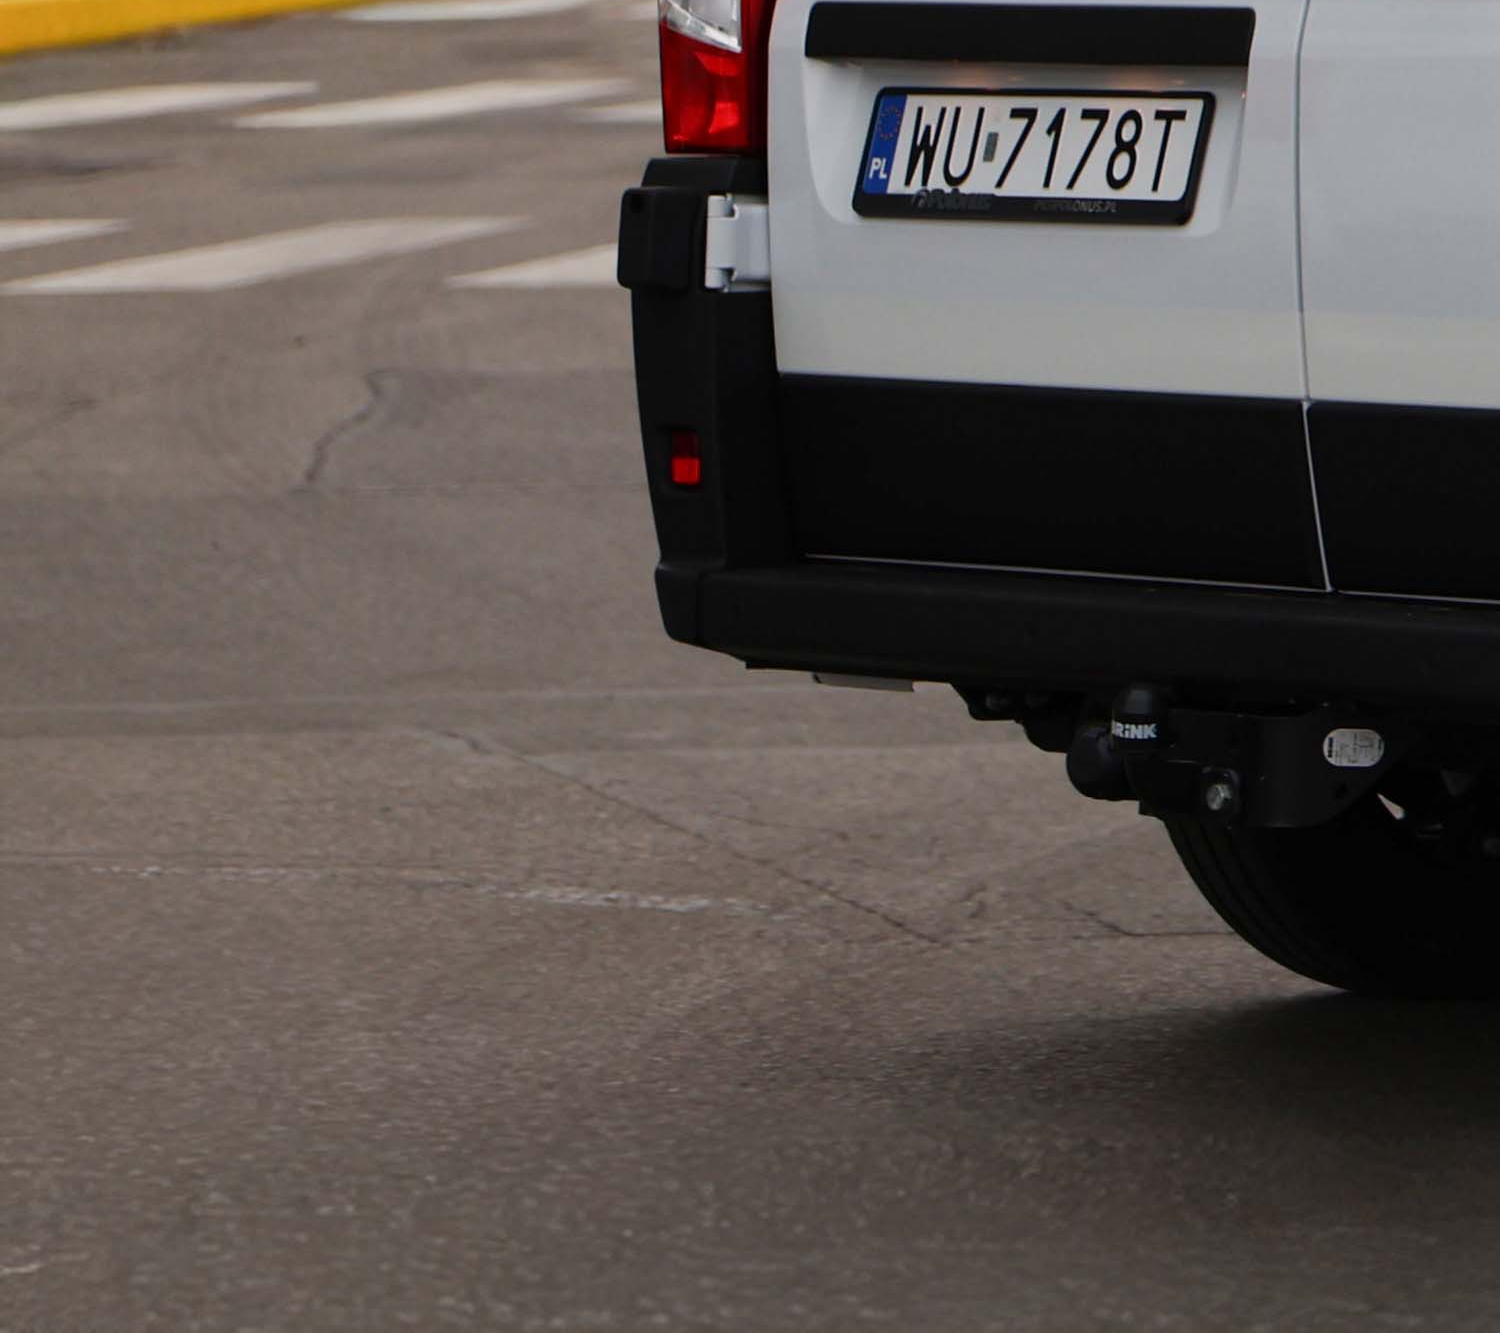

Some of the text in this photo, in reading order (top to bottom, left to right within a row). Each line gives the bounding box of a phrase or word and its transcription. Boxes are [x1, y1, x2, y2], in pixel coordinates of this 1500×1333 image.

[868, 157, 888, 180] PL
[904, 106, 1187, 192] WU 7178T
